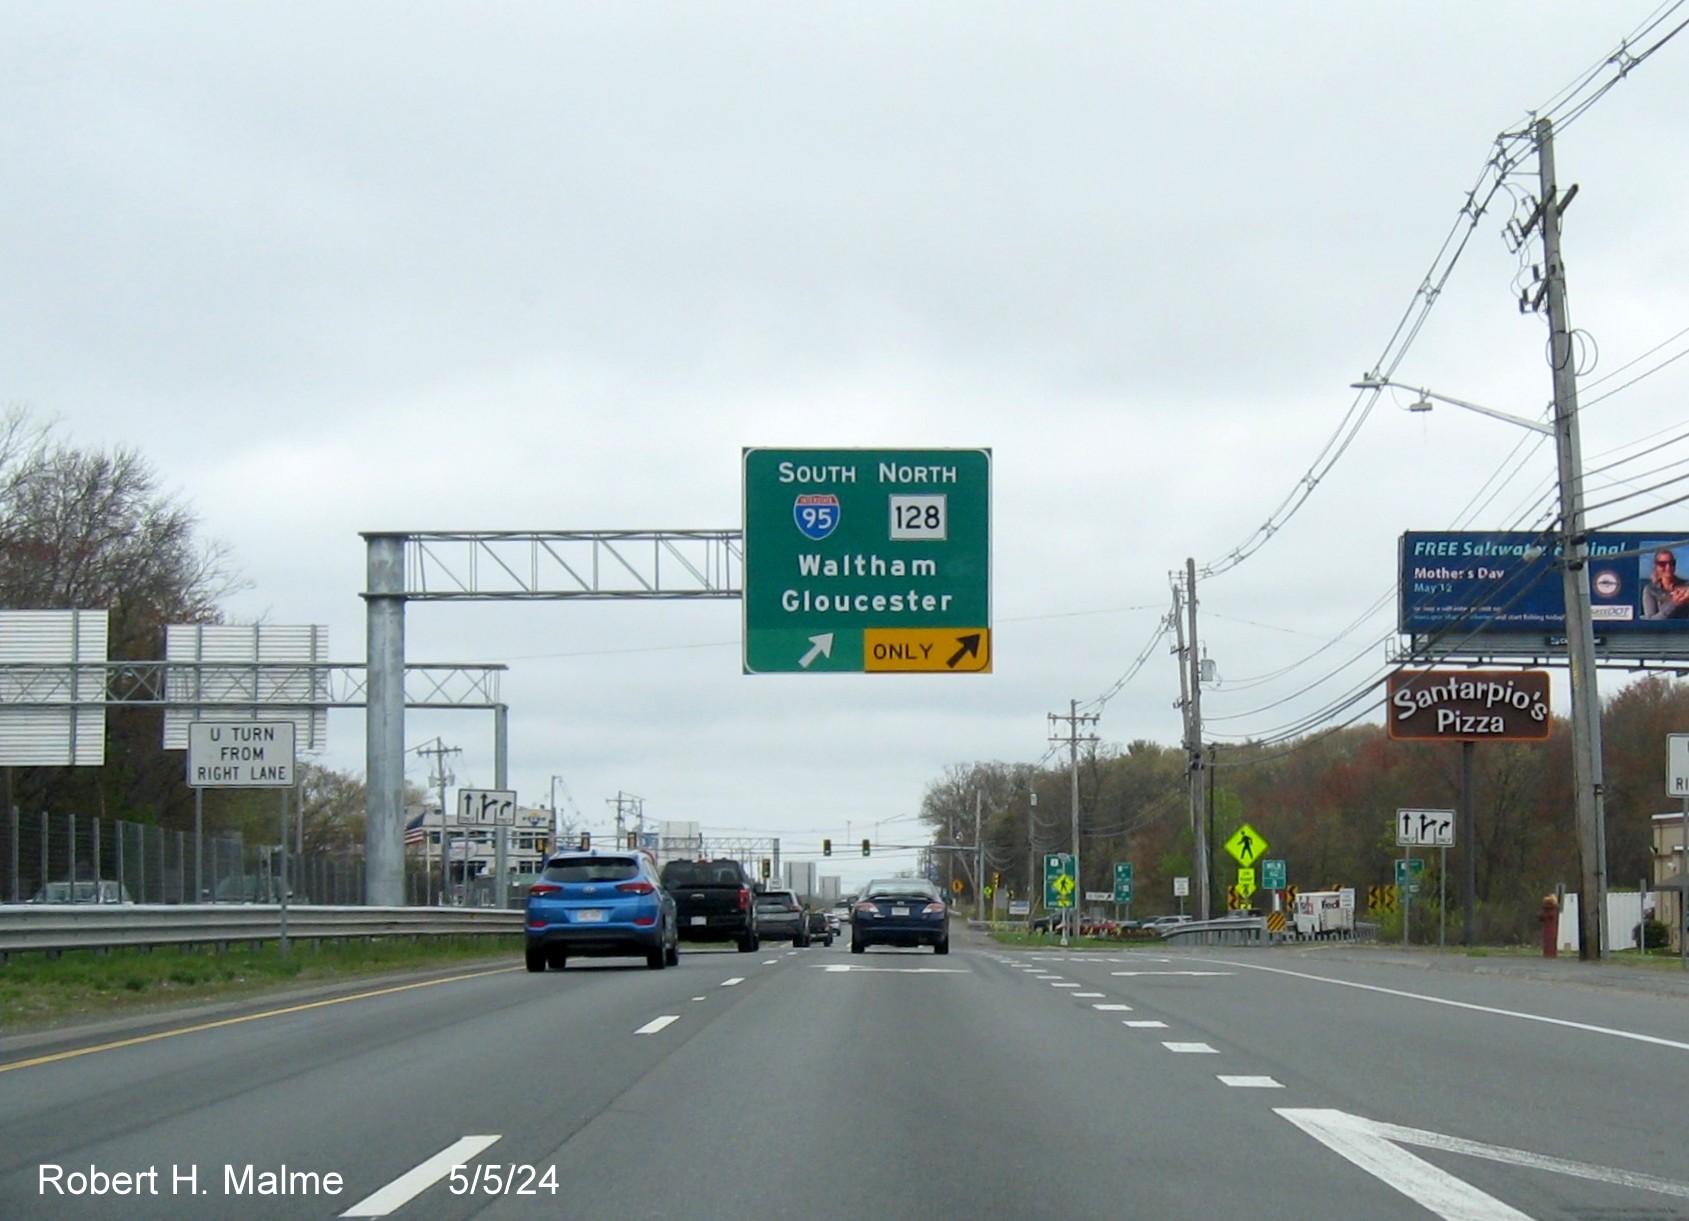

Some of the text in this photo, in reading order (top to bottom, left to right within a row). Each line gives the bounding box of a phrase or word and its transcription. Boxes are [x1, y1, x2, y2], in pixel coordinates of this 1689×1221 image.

[778, 462, 957, 483] SOUTH NORTH
[802, 508, 832, 529] 95
[895, 505, 940, 529] 128
[1414, 541, 1458, 556] FREE
[798, 554, 936, 576] Waltham
[1414, 583, 1452, 594] May 12
[781, 589, 952, 612] Gloucester
[873, 643, 934, 660] ONLY
[1393, 676, 1548, 722] Santarpio's
[1437, 709, 1504, 733] Pizza
[210, 727, 275, 741] U TURN
[221, 747, 264, 761] FROM
[197, 766, 286, 781] RIGHT LANE
